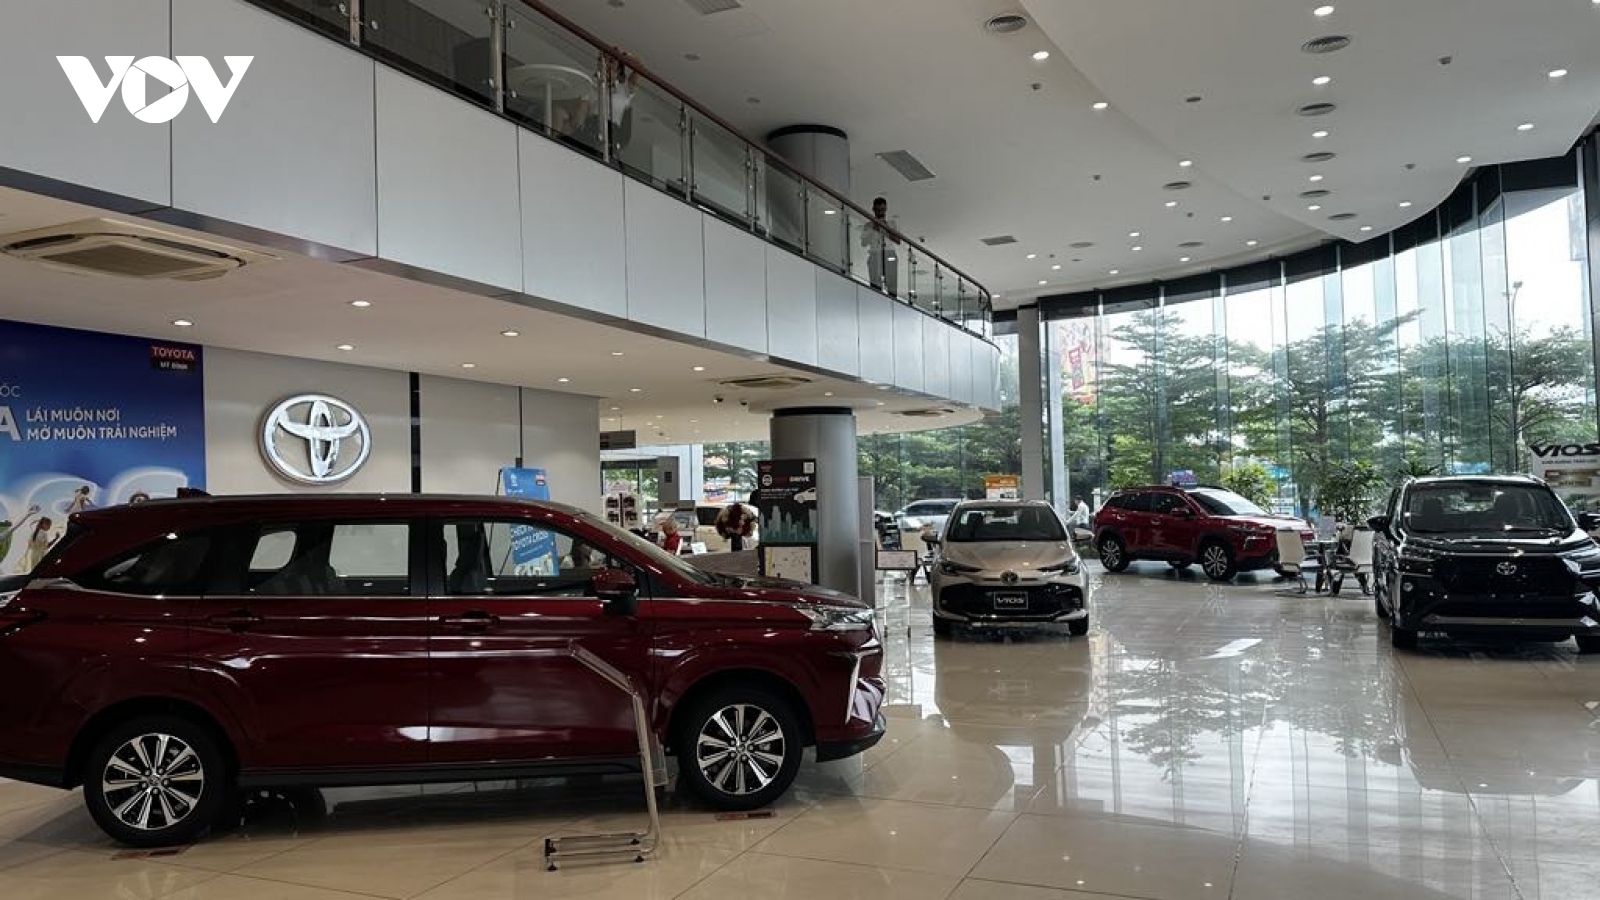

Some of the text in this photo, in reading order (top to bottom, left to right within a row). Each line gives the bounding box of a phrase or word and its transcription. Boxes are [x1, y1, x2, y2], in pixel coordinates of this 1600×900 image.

[152, 346, 195, 360] TOYOTA
[26, 406, 120, 422] LÁI MUÔN NƠI
[55, 425, 96, 440] MUÔN
[129, 422, 177, 442] NGHIỆM
